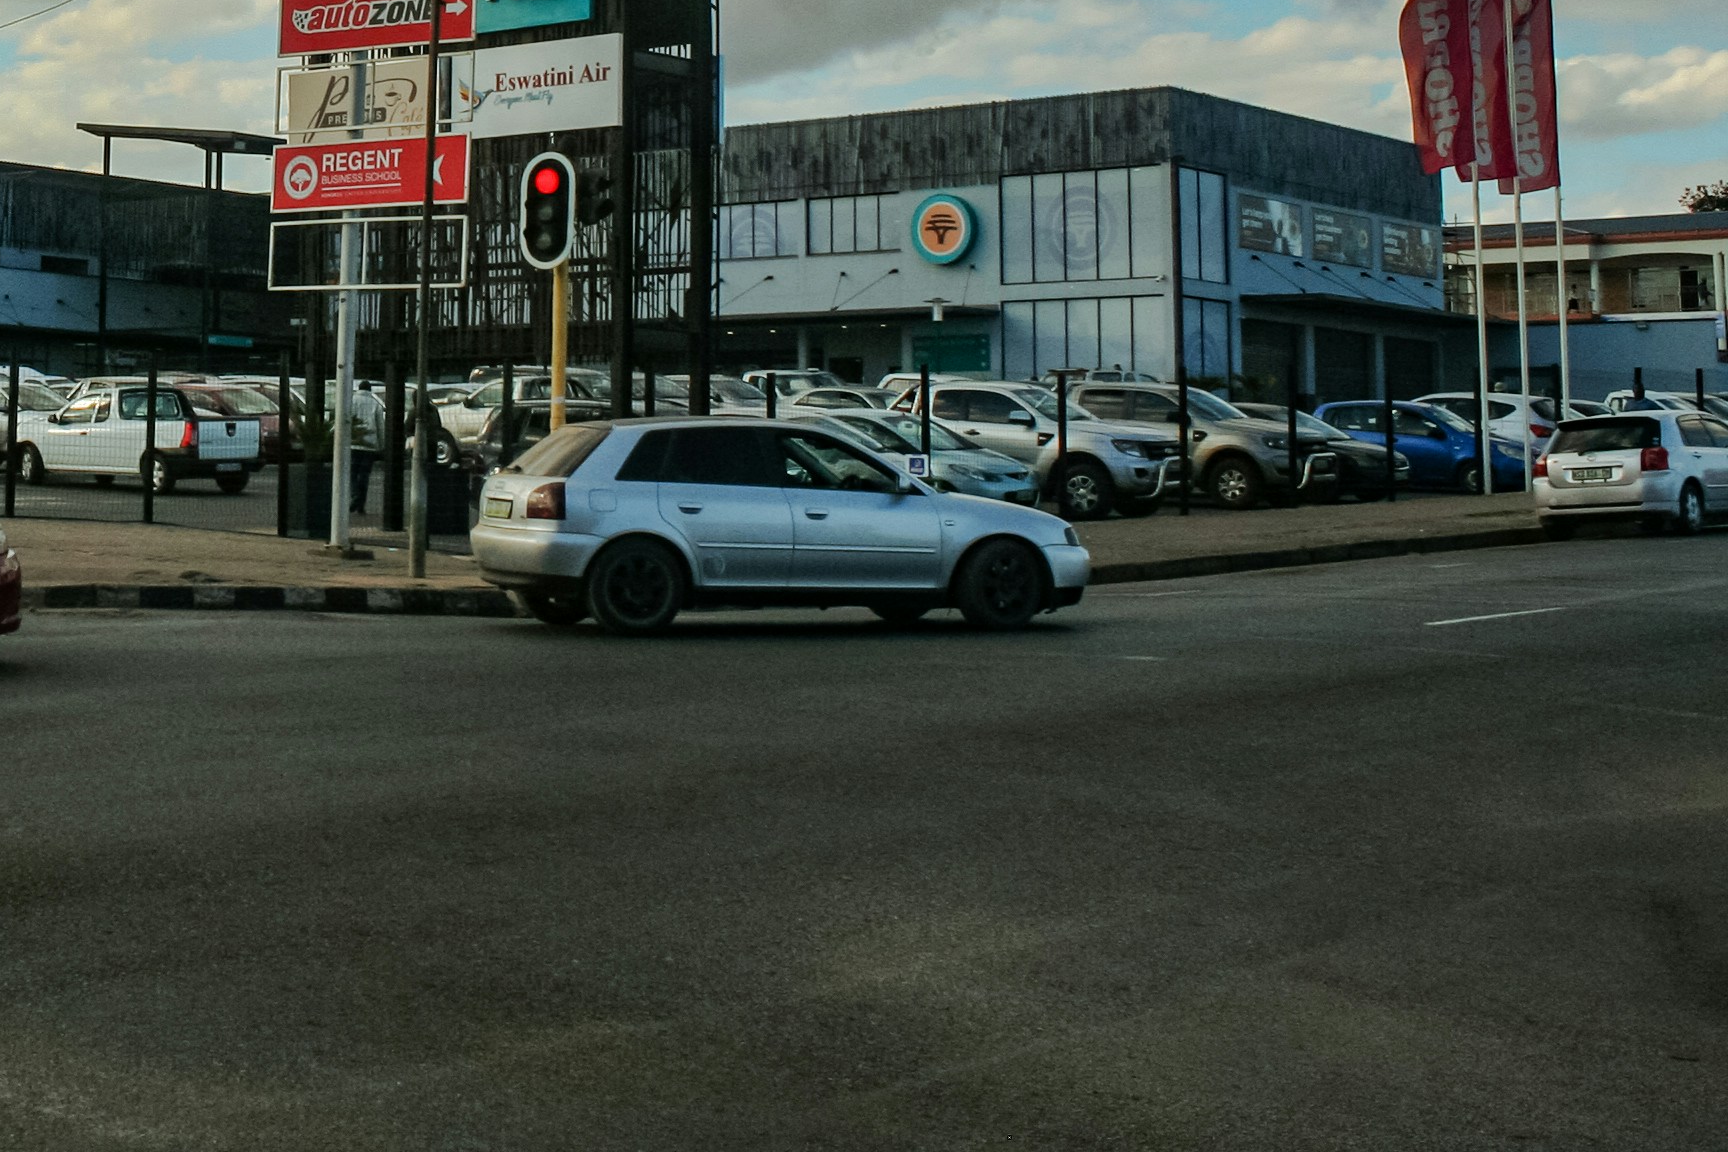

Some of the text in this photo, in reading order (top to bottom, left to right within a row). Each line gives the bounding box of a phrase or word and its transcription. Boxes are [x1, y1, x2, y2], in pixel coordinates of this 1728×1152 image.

[494, 61, 611, 93] Eswatini Air
[322, 148, 403, 173] REGENT
[322, 171, 402, 185] BUSINESS SCHOOL
